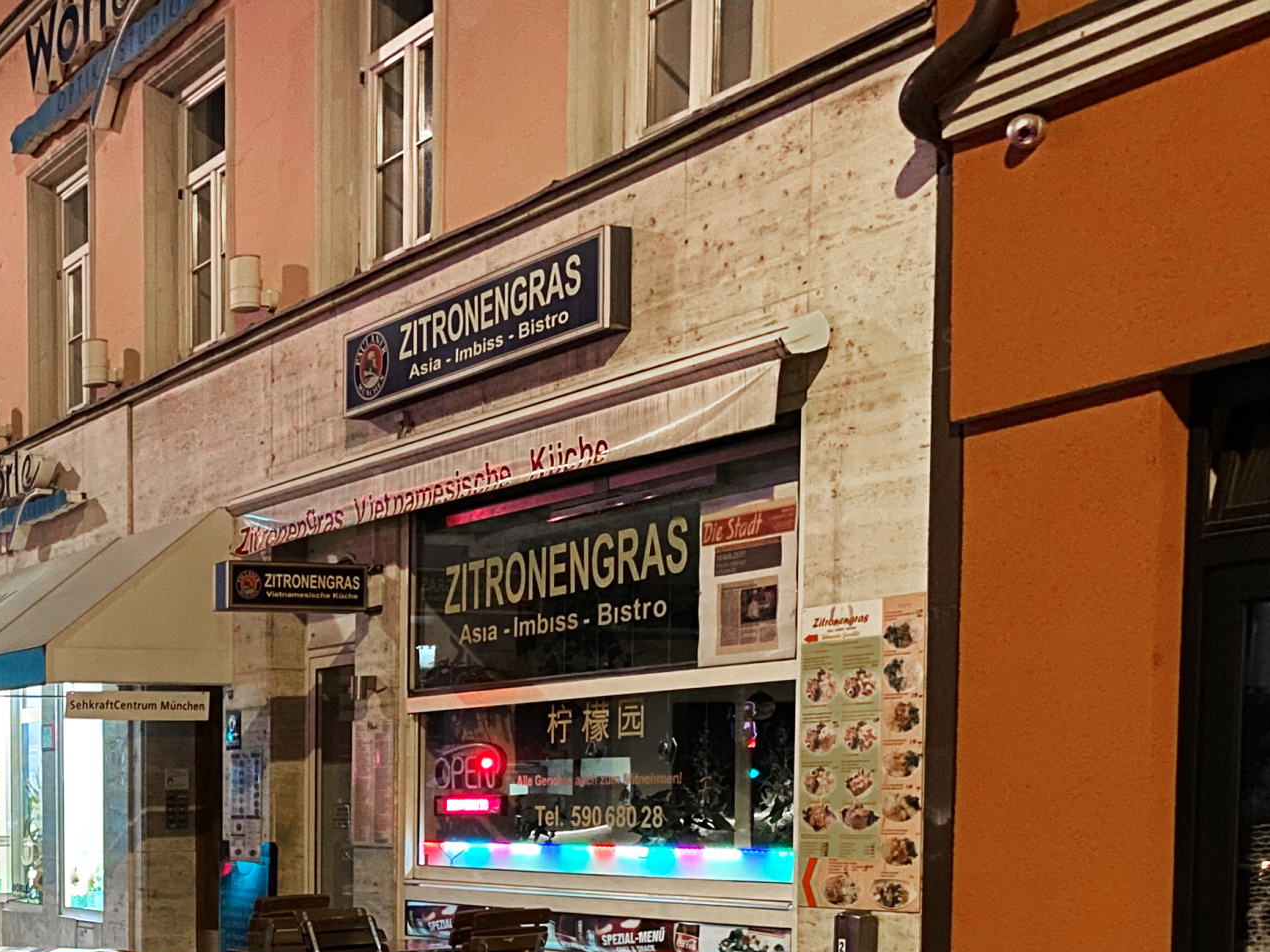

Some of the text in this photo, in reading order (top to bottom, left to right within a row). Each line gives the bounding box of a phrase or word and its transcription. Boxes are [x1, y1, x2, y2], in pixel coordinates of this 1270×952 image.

[398, 253, 582, 361] ZITRONENGRAS
[408, 357, 442, 380] Asia
[454, 334, 504, 363] Imbiss
[517, 310, 570, 340] Bistro
[353, 462, 512, 526] Vietnamesische
[529, 435, 609, 476] Küche
[703, 522, 723, 544] Die
[726, 512, 763, 541] Stadt
[444, 516, 689, 615] ZITRONENGRAS
[264, 573, 361, 591] ZITRONENGRAS
[266, 591, 331, 599] Vietnamesische
[332, 591, 359, 600] Küche
[812, 614, 870, 628] Zitronengras
[69, 699, 205, 711] SehkraftCentrum München
[546, 698, 645, 744] 柠檬园
[435, 755, 496, 789] OPEN
[517, 774, 533, 787] Alle
[534, 805, 663, 829] Tel. 590 680 28
[601, 927, 665, 947] SPEZIAL-MENÜ
[839, 941, 845, 952] 2
